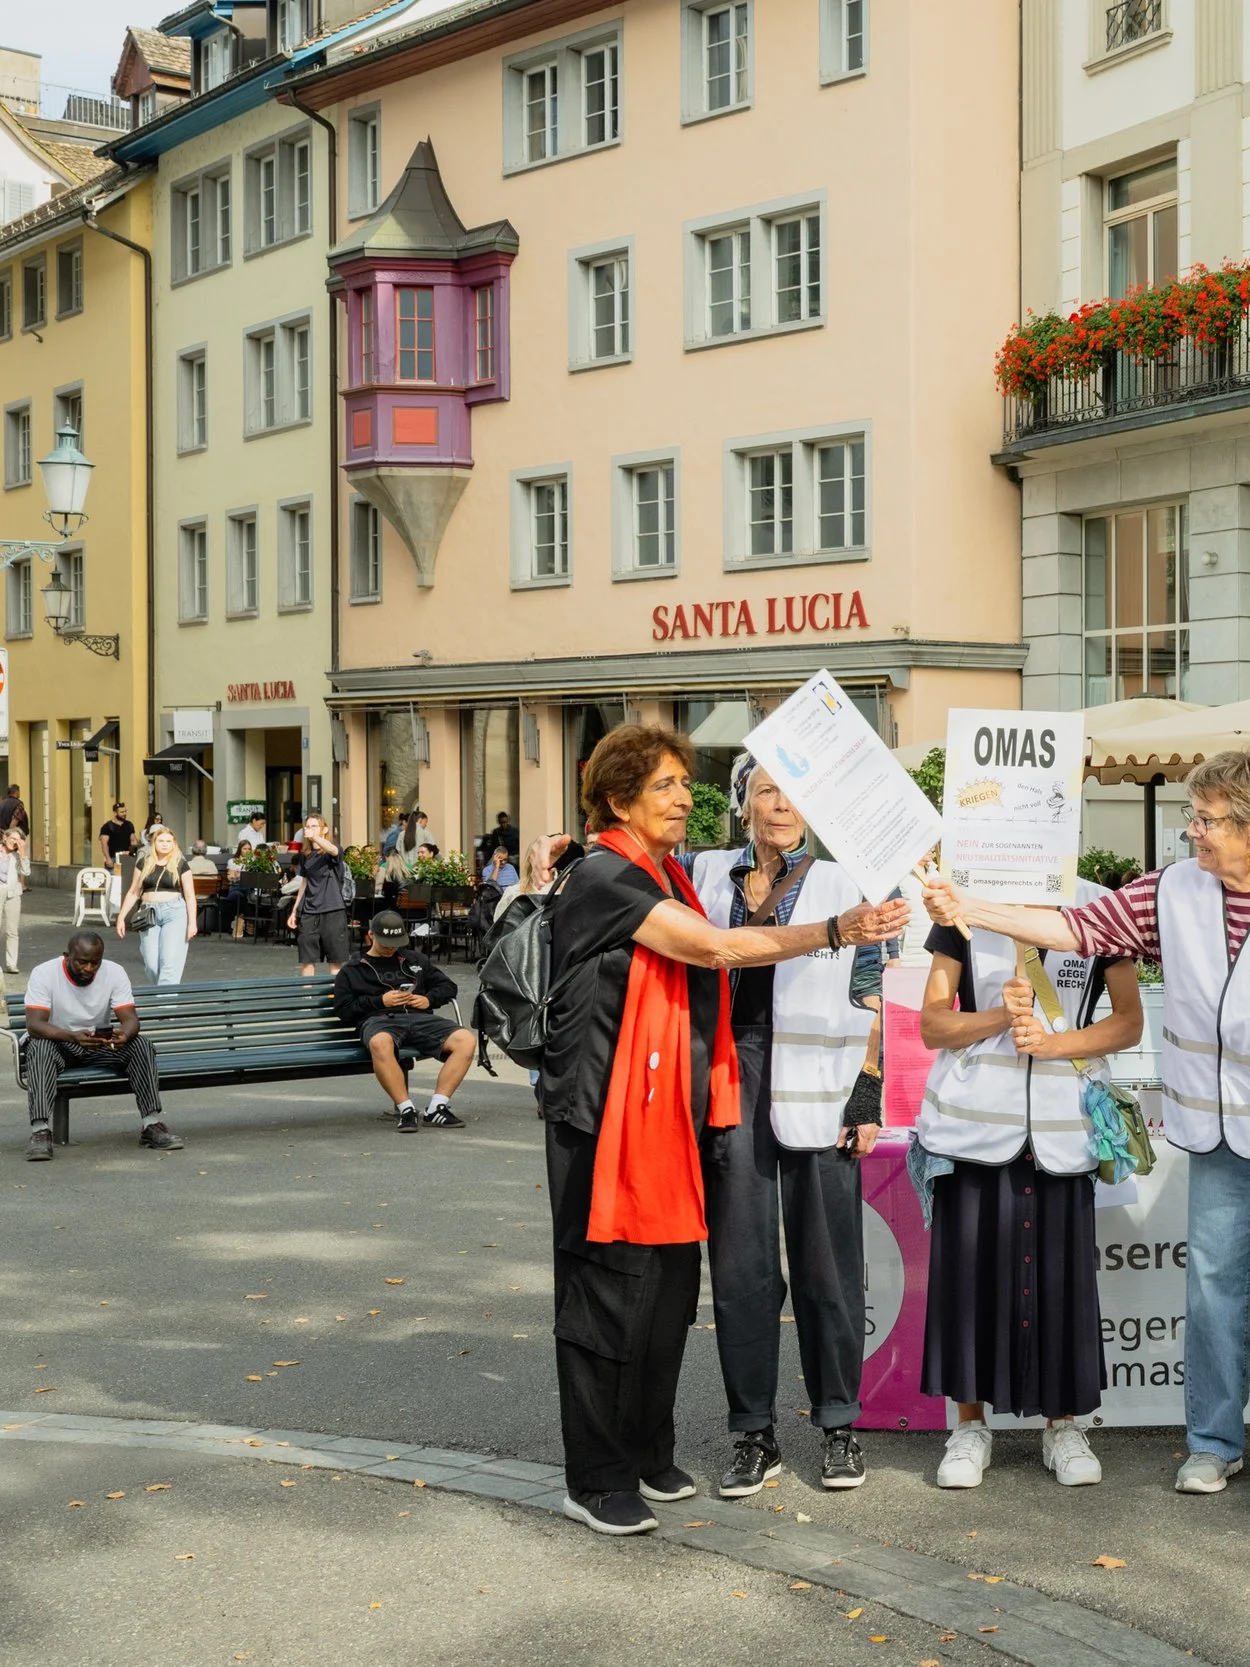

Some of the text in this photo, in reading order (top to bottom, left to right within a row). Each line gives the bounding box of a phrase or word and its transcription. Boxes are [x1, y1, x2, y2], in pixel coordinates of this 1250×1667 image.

[652, 590, 870, 641] SANTA LUCIA
[227, 681, 296, 702] SANTA LUCIA
[974, 726, 1056, 769] OMAS
[1017, 782, 1029, 791] den
[959, 789, 998, 807] KRIEGEN
[1013, 801, 1042, 812] nicht voll
[956, 839, 979, 848] NEIN
[995, 842, 1044, 850] SOGENANNTEN
[973, 878, 1043, 887] omasgegenrechts.ch
[1058, 969, 1086, 978] GEGE
